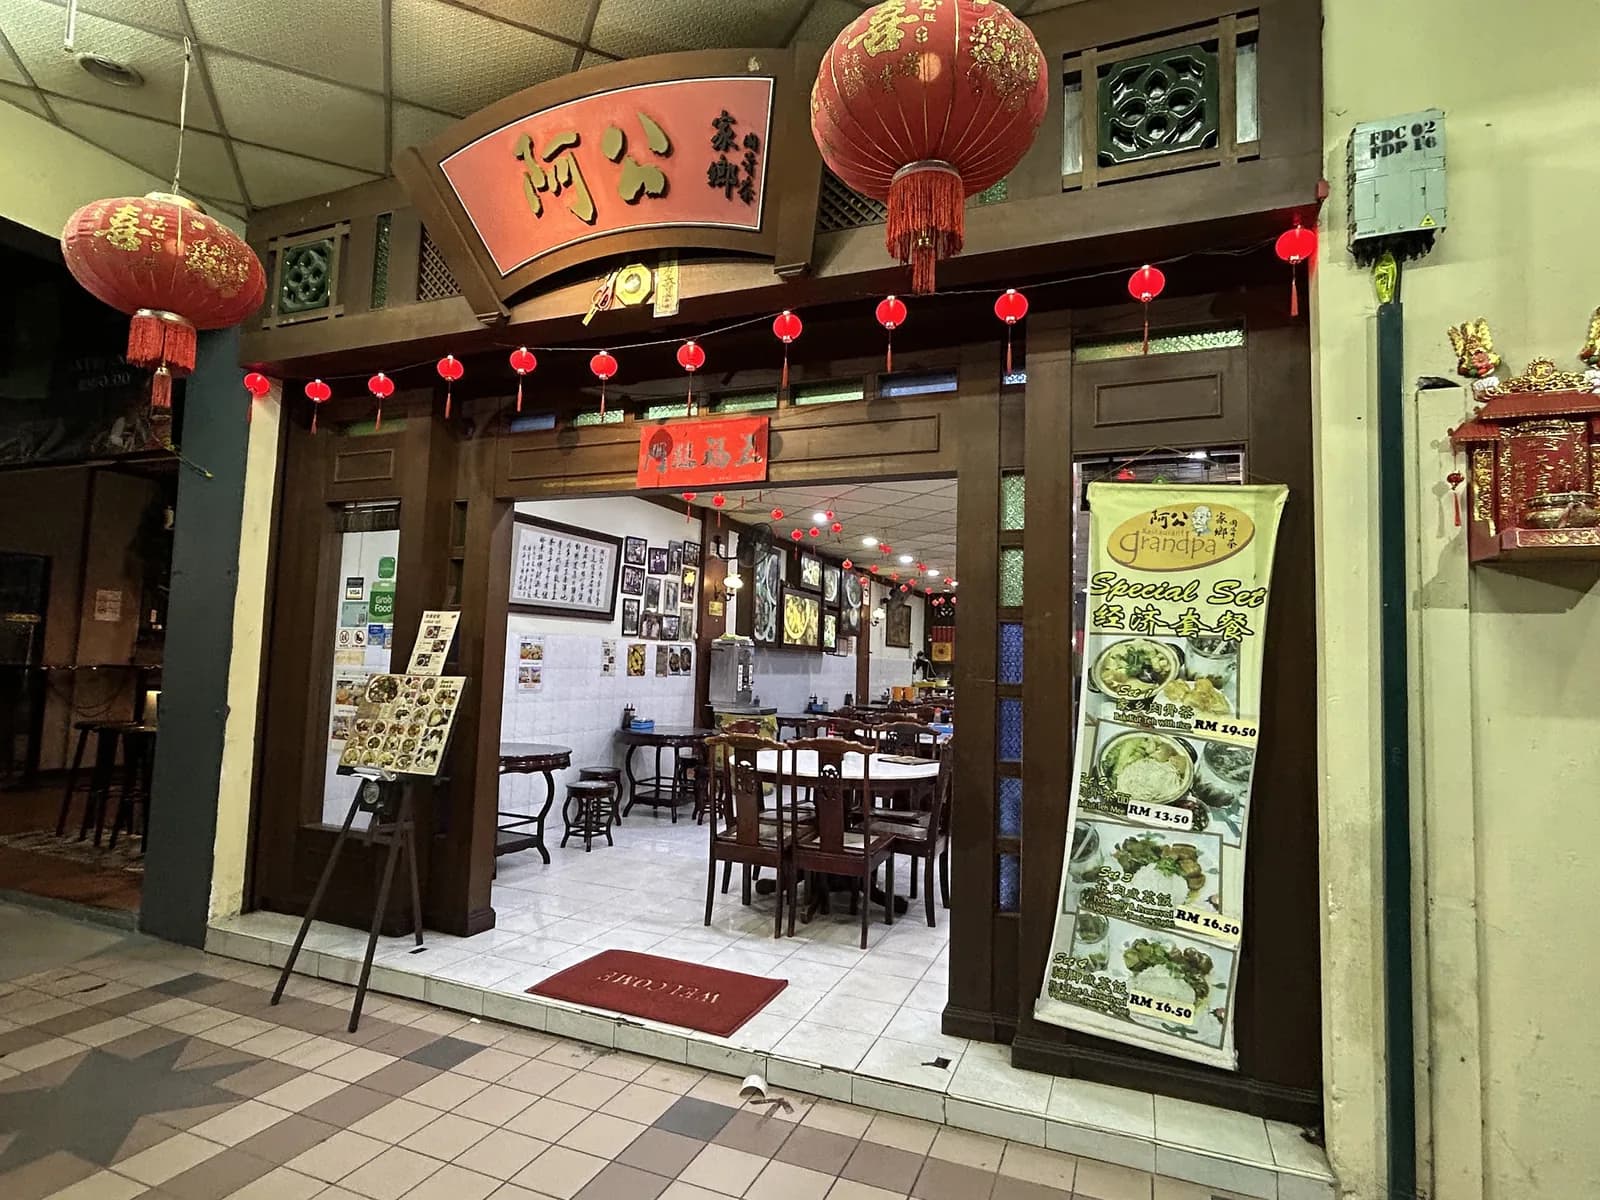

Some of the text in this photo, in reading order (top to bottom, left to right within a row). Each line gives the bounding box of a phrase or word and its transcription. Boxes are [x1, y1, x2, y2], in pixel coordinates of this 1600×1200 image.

[1369, 126, 1406, 146] FDC
[1370, 136, 1437, 159] FDP 16
[512, 111, 674, 226] 阿公
[1150, 510, 1188, 529] 阿公
[1120, 531, 1217, 564] grandpa
[375, 595, 392, 604] Grab
[1090, 571, 1267, 609] Special Set
[374, 604, 392, 613] Food
[1093, 604, 1255, 642] 经济套餐
[1118, 685, 1141, 698] Set
[1194, 719, 1257, 737] RM 19.50
[1098, 776, 1108, 786] 2
[1128, 804, 1189, 824] RM 13.50
[1098, 866, 1133, 883] Set 3
[1176, 909, 1199, 924] RM
[1203, 918, 1240, 935] 16.50
[1053, 952, 1088, 969] Set 4
[596, 971, 720, 1004] WELCOME
[1129, 994, 1152, 1009] RM
[1155, 1003, 1192, 1019] 16.50
